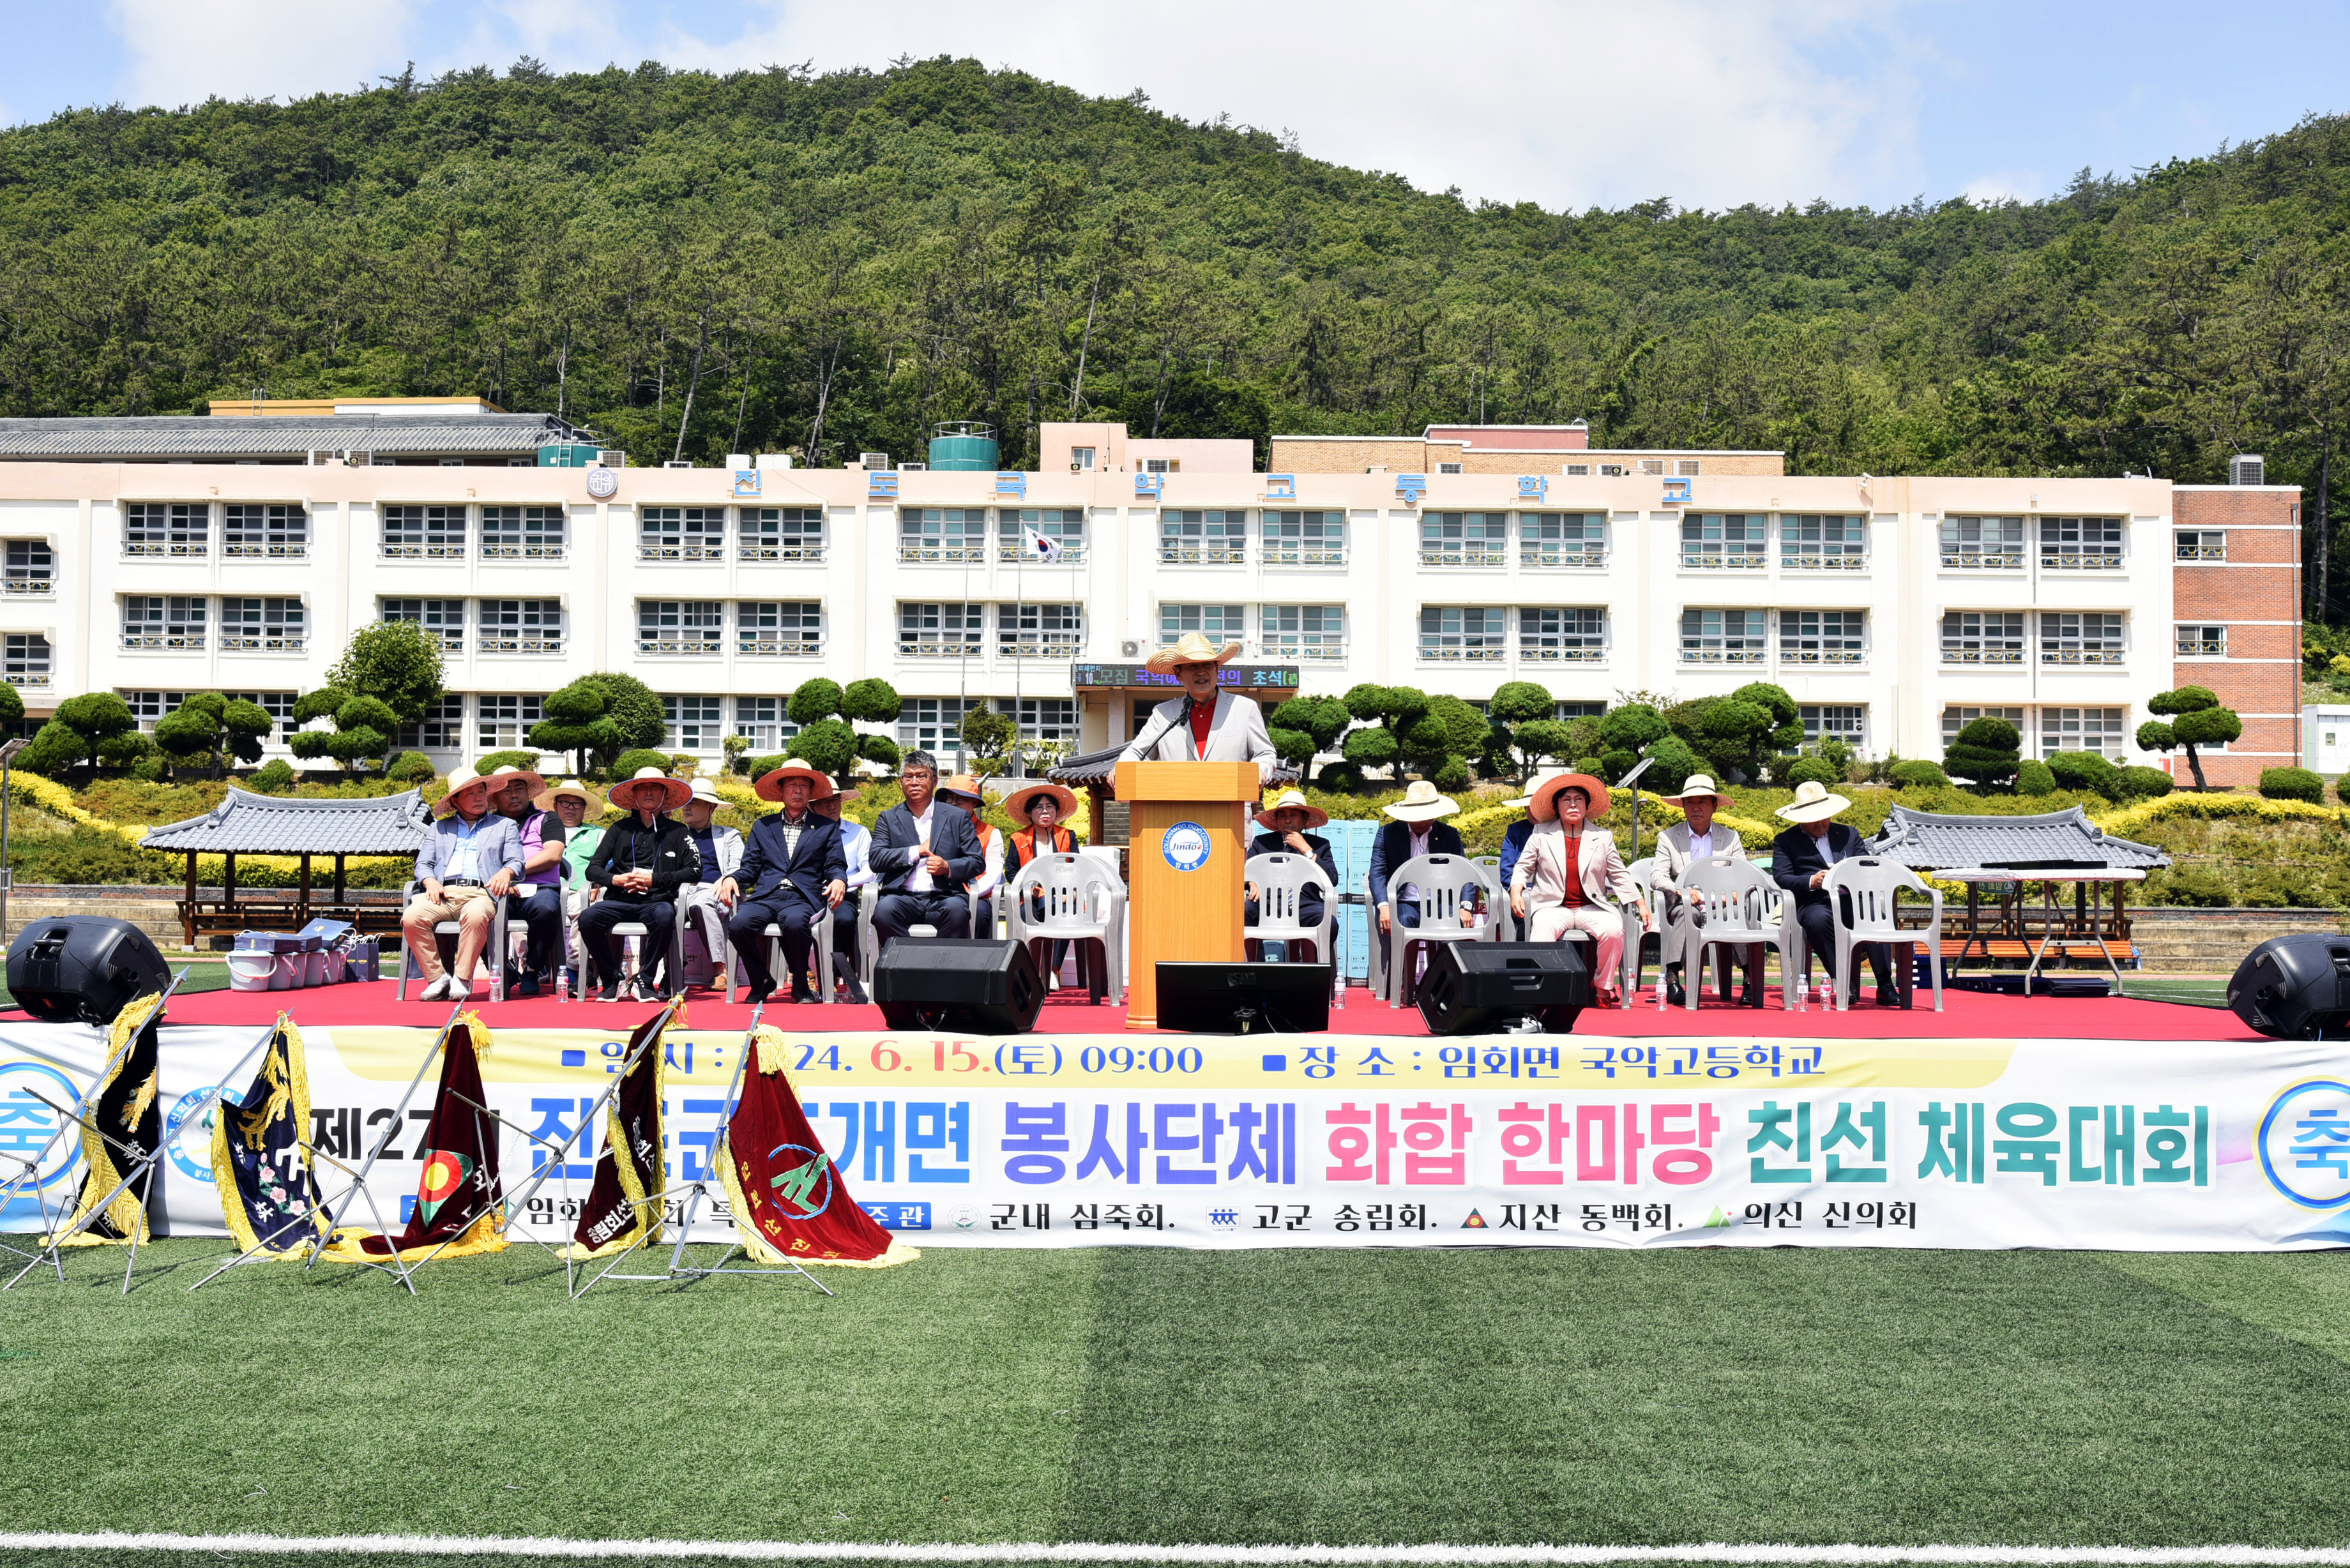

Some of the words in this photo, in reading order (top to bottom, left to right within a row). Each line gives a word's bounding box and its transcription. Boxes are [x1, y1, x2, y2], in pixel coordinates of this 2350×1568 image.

[1085, 672, 1093, 685] 10
[1101, 669, 1128, 684] 모집
[1171, 843, 1197, 851] Jindo
[1187, 824, 1202, 833] JINDO
[1201, 832, 1209, 856] COUNTY
[870, 1040, 913, 1072] 6.
[1080, 1046, 1203, 1073] 09:00
[1439, 1046, 1559, 1078] 임회면
[1580, 1045, 1825, 1079] 국악고등학교
[311, 1108, 500, 1161] 제27
[529, 1097, 739, 1182] 진군
[1001, 1101, 1296, 1185] 봉사단체
[1326, 1102, 1473, 1186] 화합
[1498, 1102, 1720, 1186] 한마당
[1747, 1101, 1888, 1184] 친선
[1918, 1102, 2209, 1187] 체육대회
[2289, 1109, 2350, 1180] 축
[990, 1203, 1050, 1230] 군내
[1070, 1203, 1175, 1231] 심죽회.
[1252, 1205, 1313, 1231] 고군
[1333, 1204, 1437, 1232] 송림회.
[1499, 1204, 1561, 1231] 지산
[1580, 1203, 1683, 1232] 동백회.
[1743, 1202, 1803, 1229] 의신
[1822, 1202, 1916, 1230] 신의회
